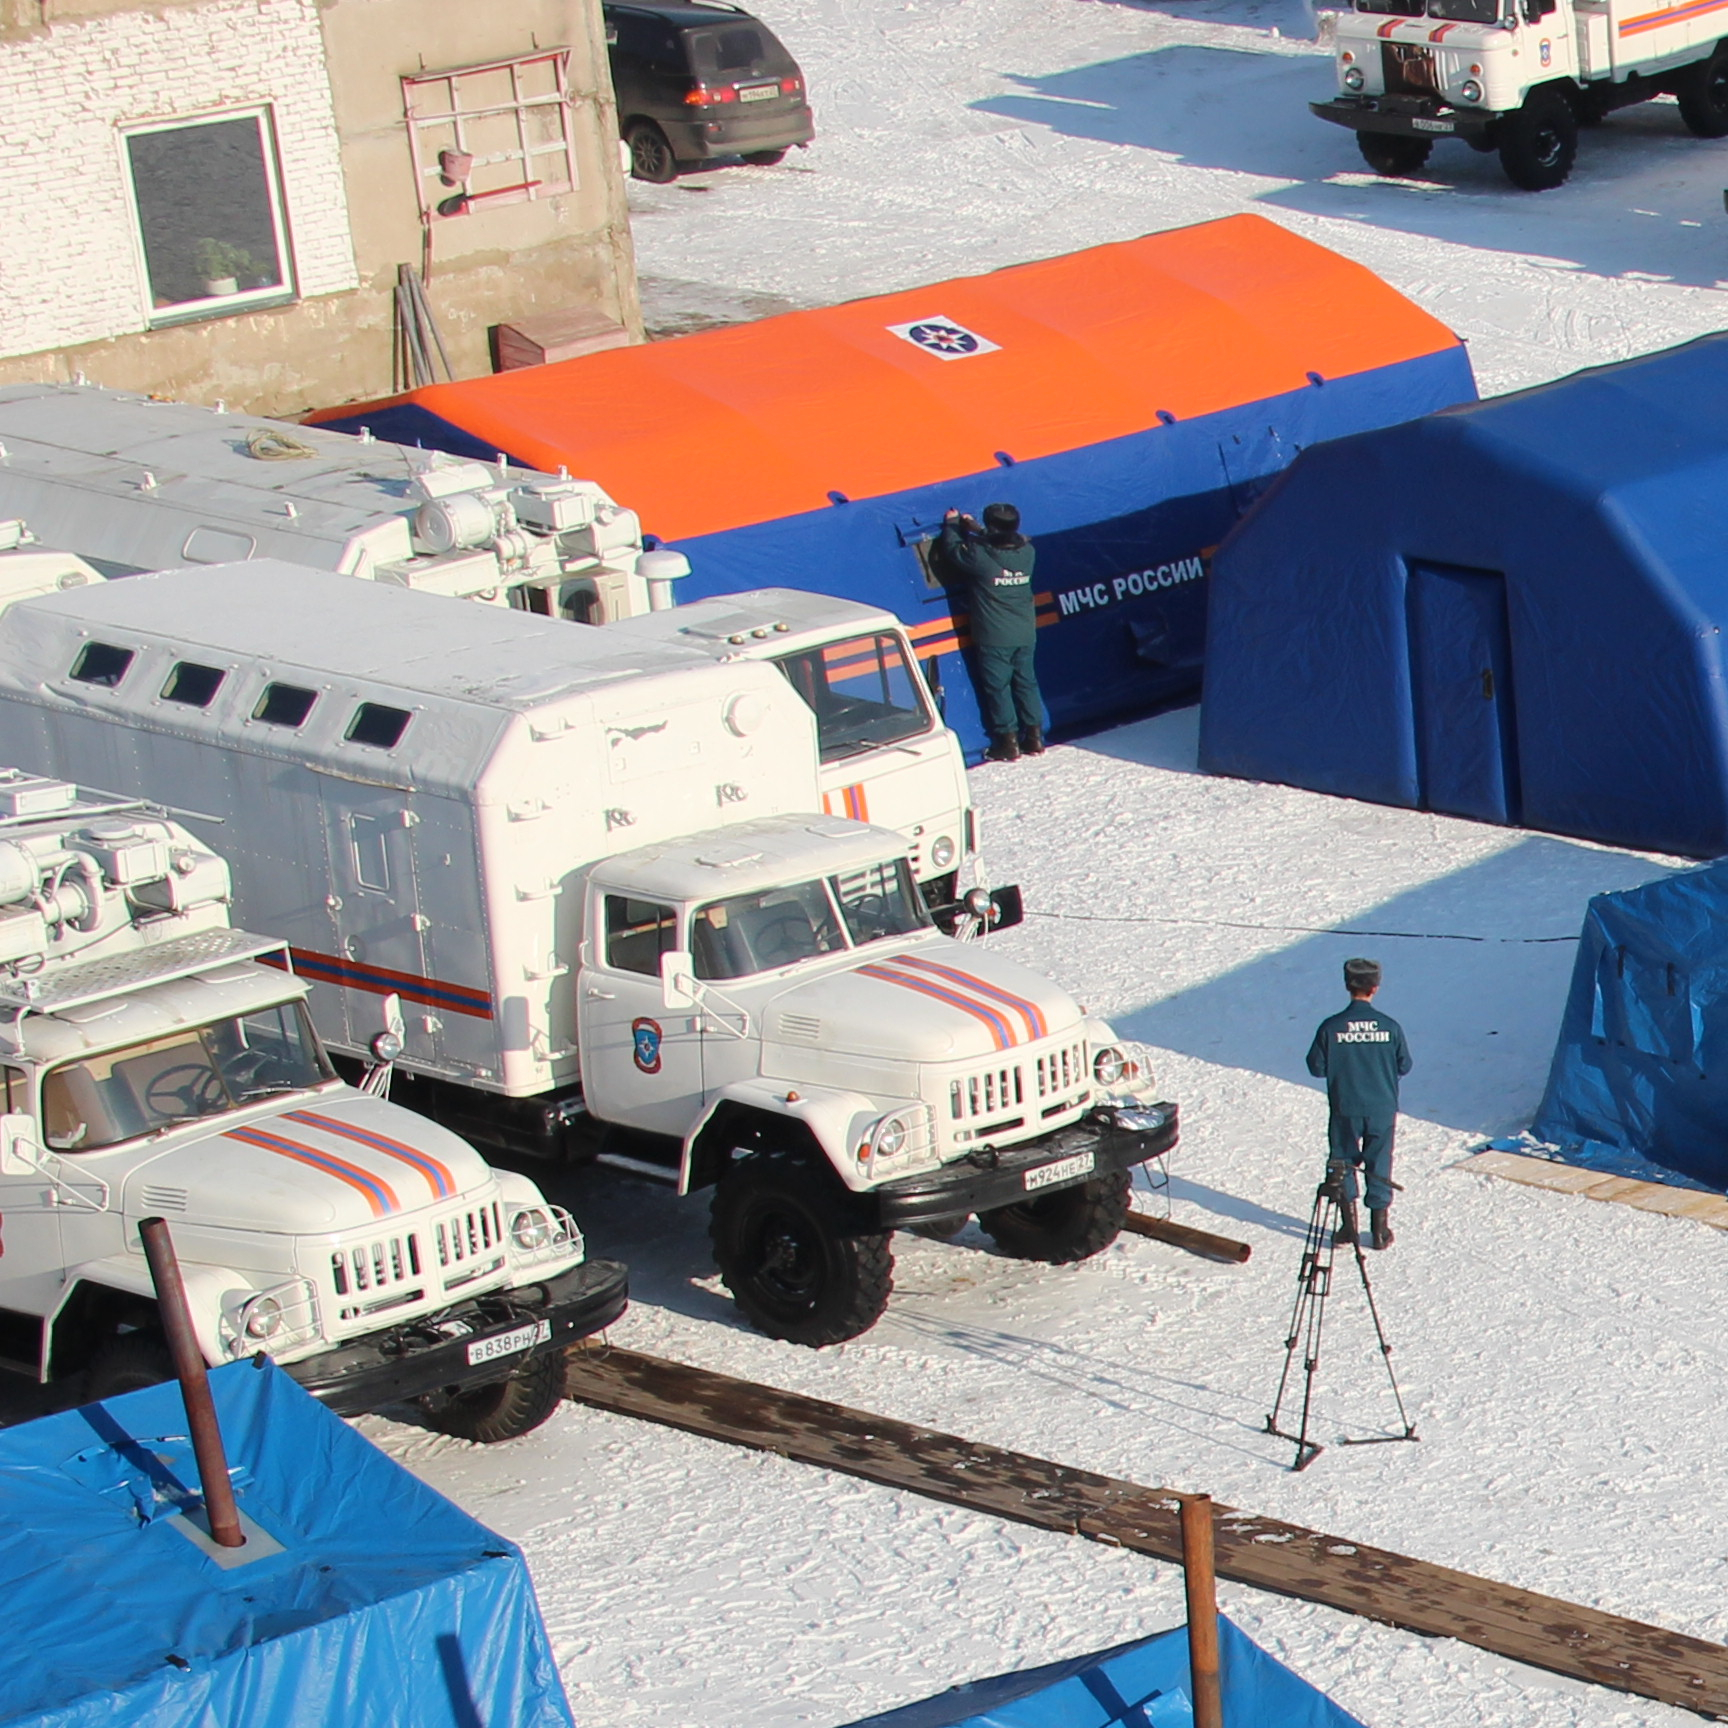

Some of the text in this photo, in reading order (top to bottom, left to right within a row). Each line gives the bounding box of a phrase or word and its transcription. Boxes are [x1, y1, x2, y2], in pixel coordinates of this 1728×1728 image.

[1058, 556, 1204, 615] МЧС РОССИИ
[1348, 1021, 1378, 1032] МЧС
[1337, 1031, 1390, 1043] РОССИИ
